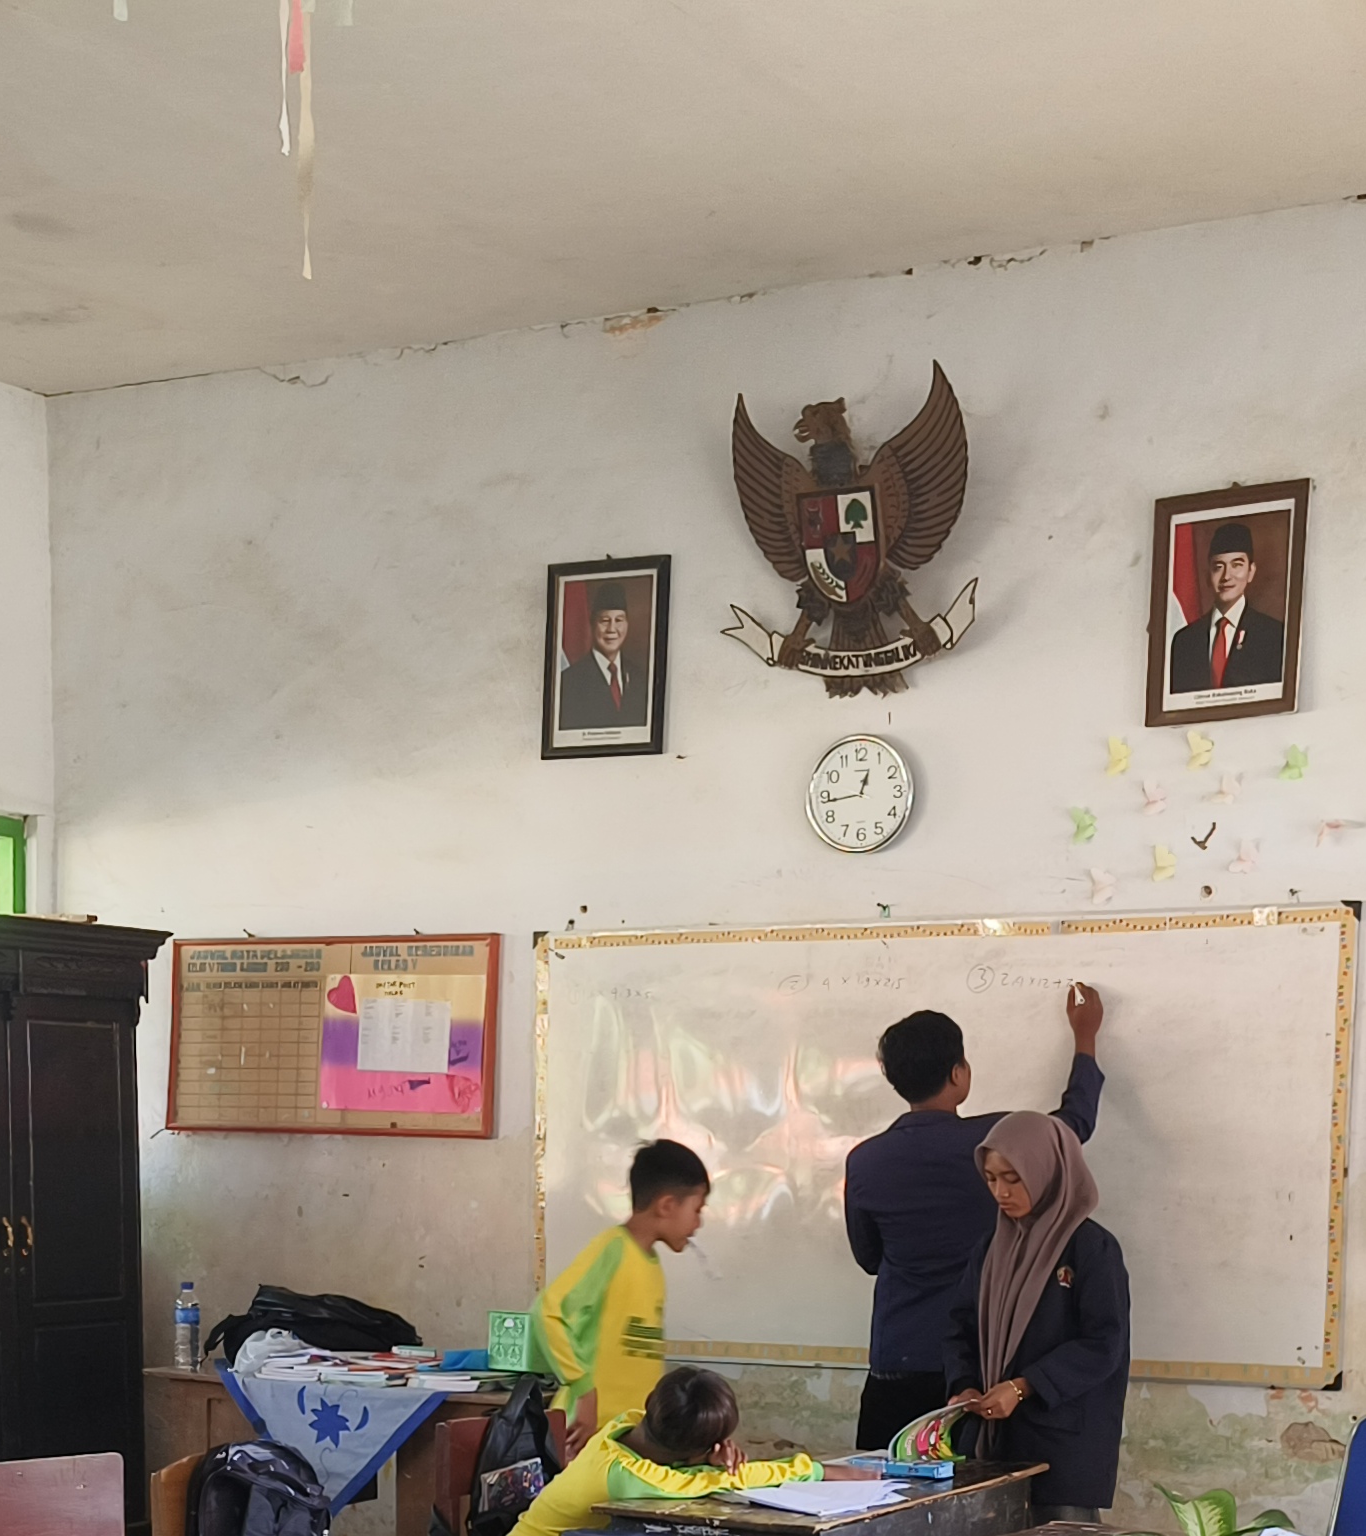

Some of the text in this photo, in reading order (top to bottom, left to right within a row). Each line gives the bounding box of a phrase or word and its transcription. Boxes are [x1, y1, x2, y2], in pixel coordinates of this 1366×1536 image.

[839, 754, 849, 769] 11
[854, 747, 868, 762] 12
[877, 751, 882, 765] 1
[825, 769, 840, 784] 10
[886, 764, 898, 780] 2
[819, 789, 831, 804] 9
[892, 784, 903, 799] 3
[825, 809, 836, 824] 8
[886, 805, 898, 819] 4
[840, 823, 850, 838] 7
[855, 827, 867, 842] 6
[873, 821, 885, 836] 5
